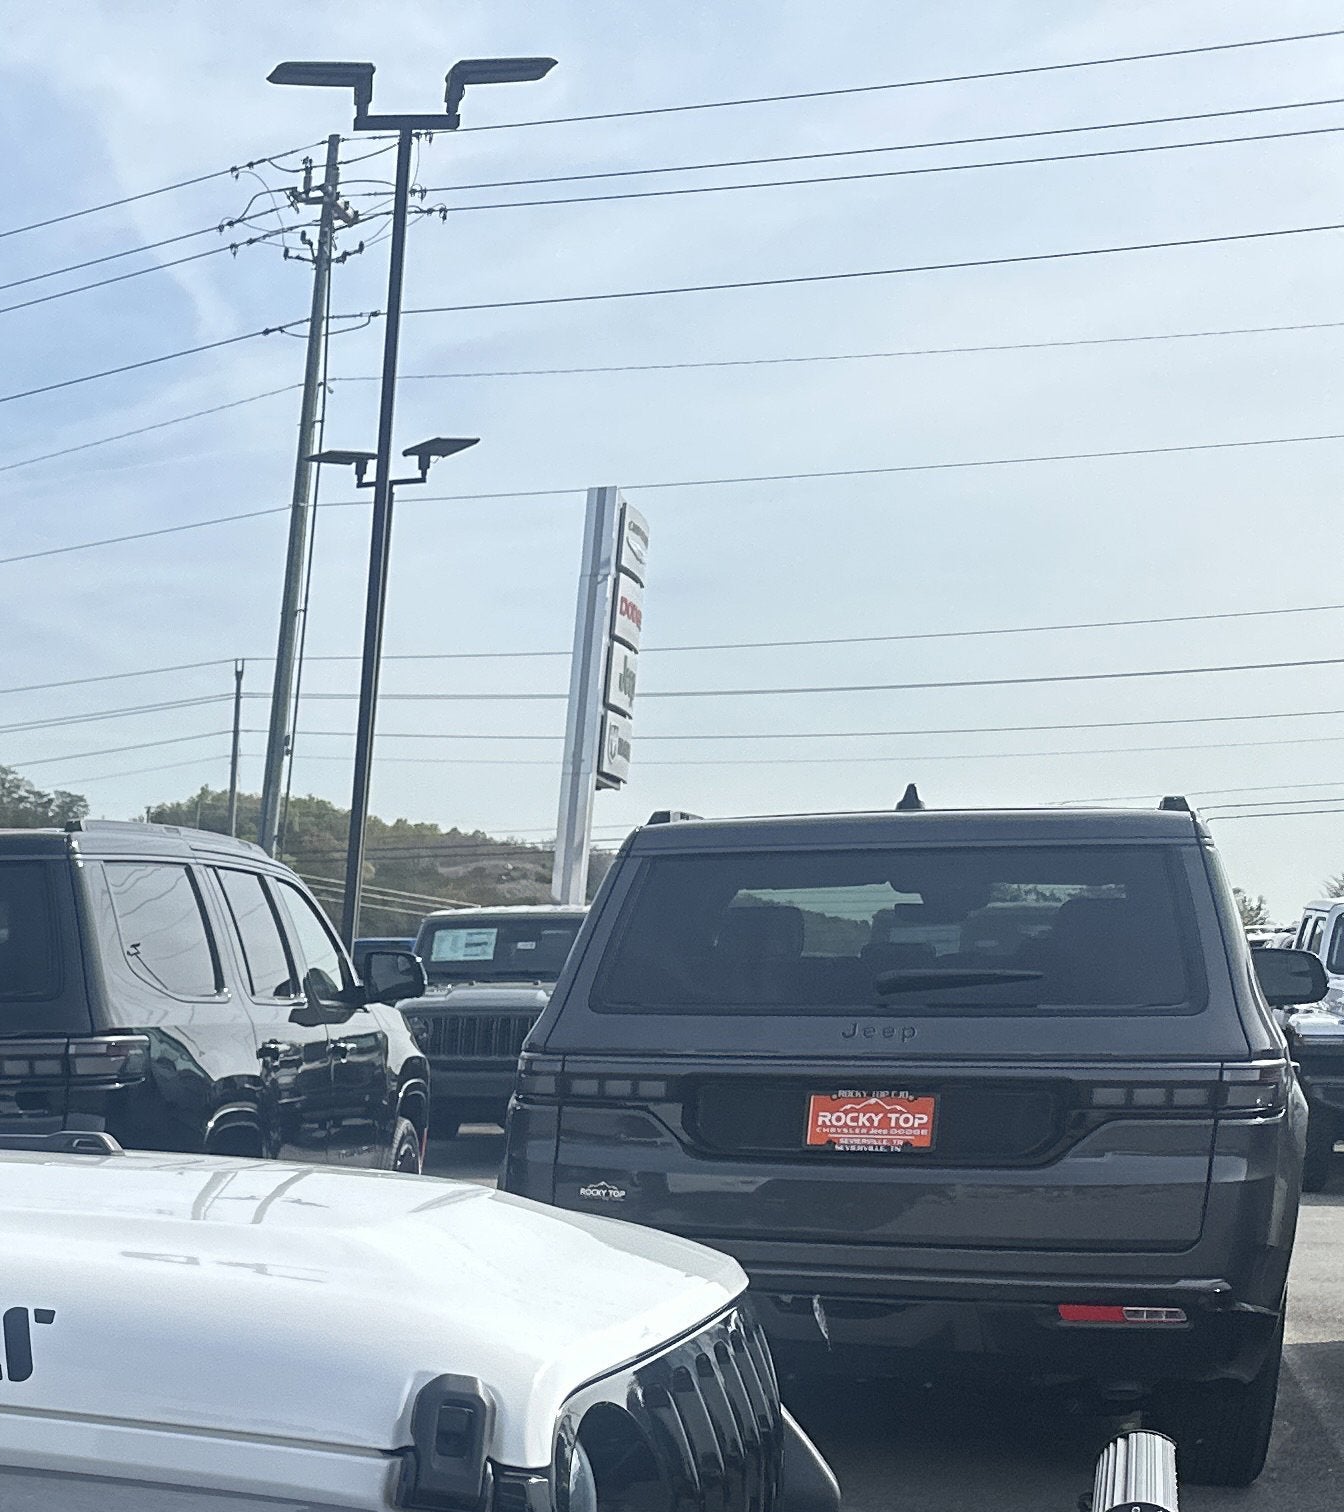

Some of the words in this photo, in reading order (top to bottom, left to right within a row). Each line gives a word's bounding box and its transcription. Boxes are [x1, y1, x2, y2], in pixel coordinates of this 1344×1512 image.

[841, 1022, 918, 1043] Jeep
[817, 1112, 883, 1127] ROCKY
[887, 1113, 928, 1128] TOP
